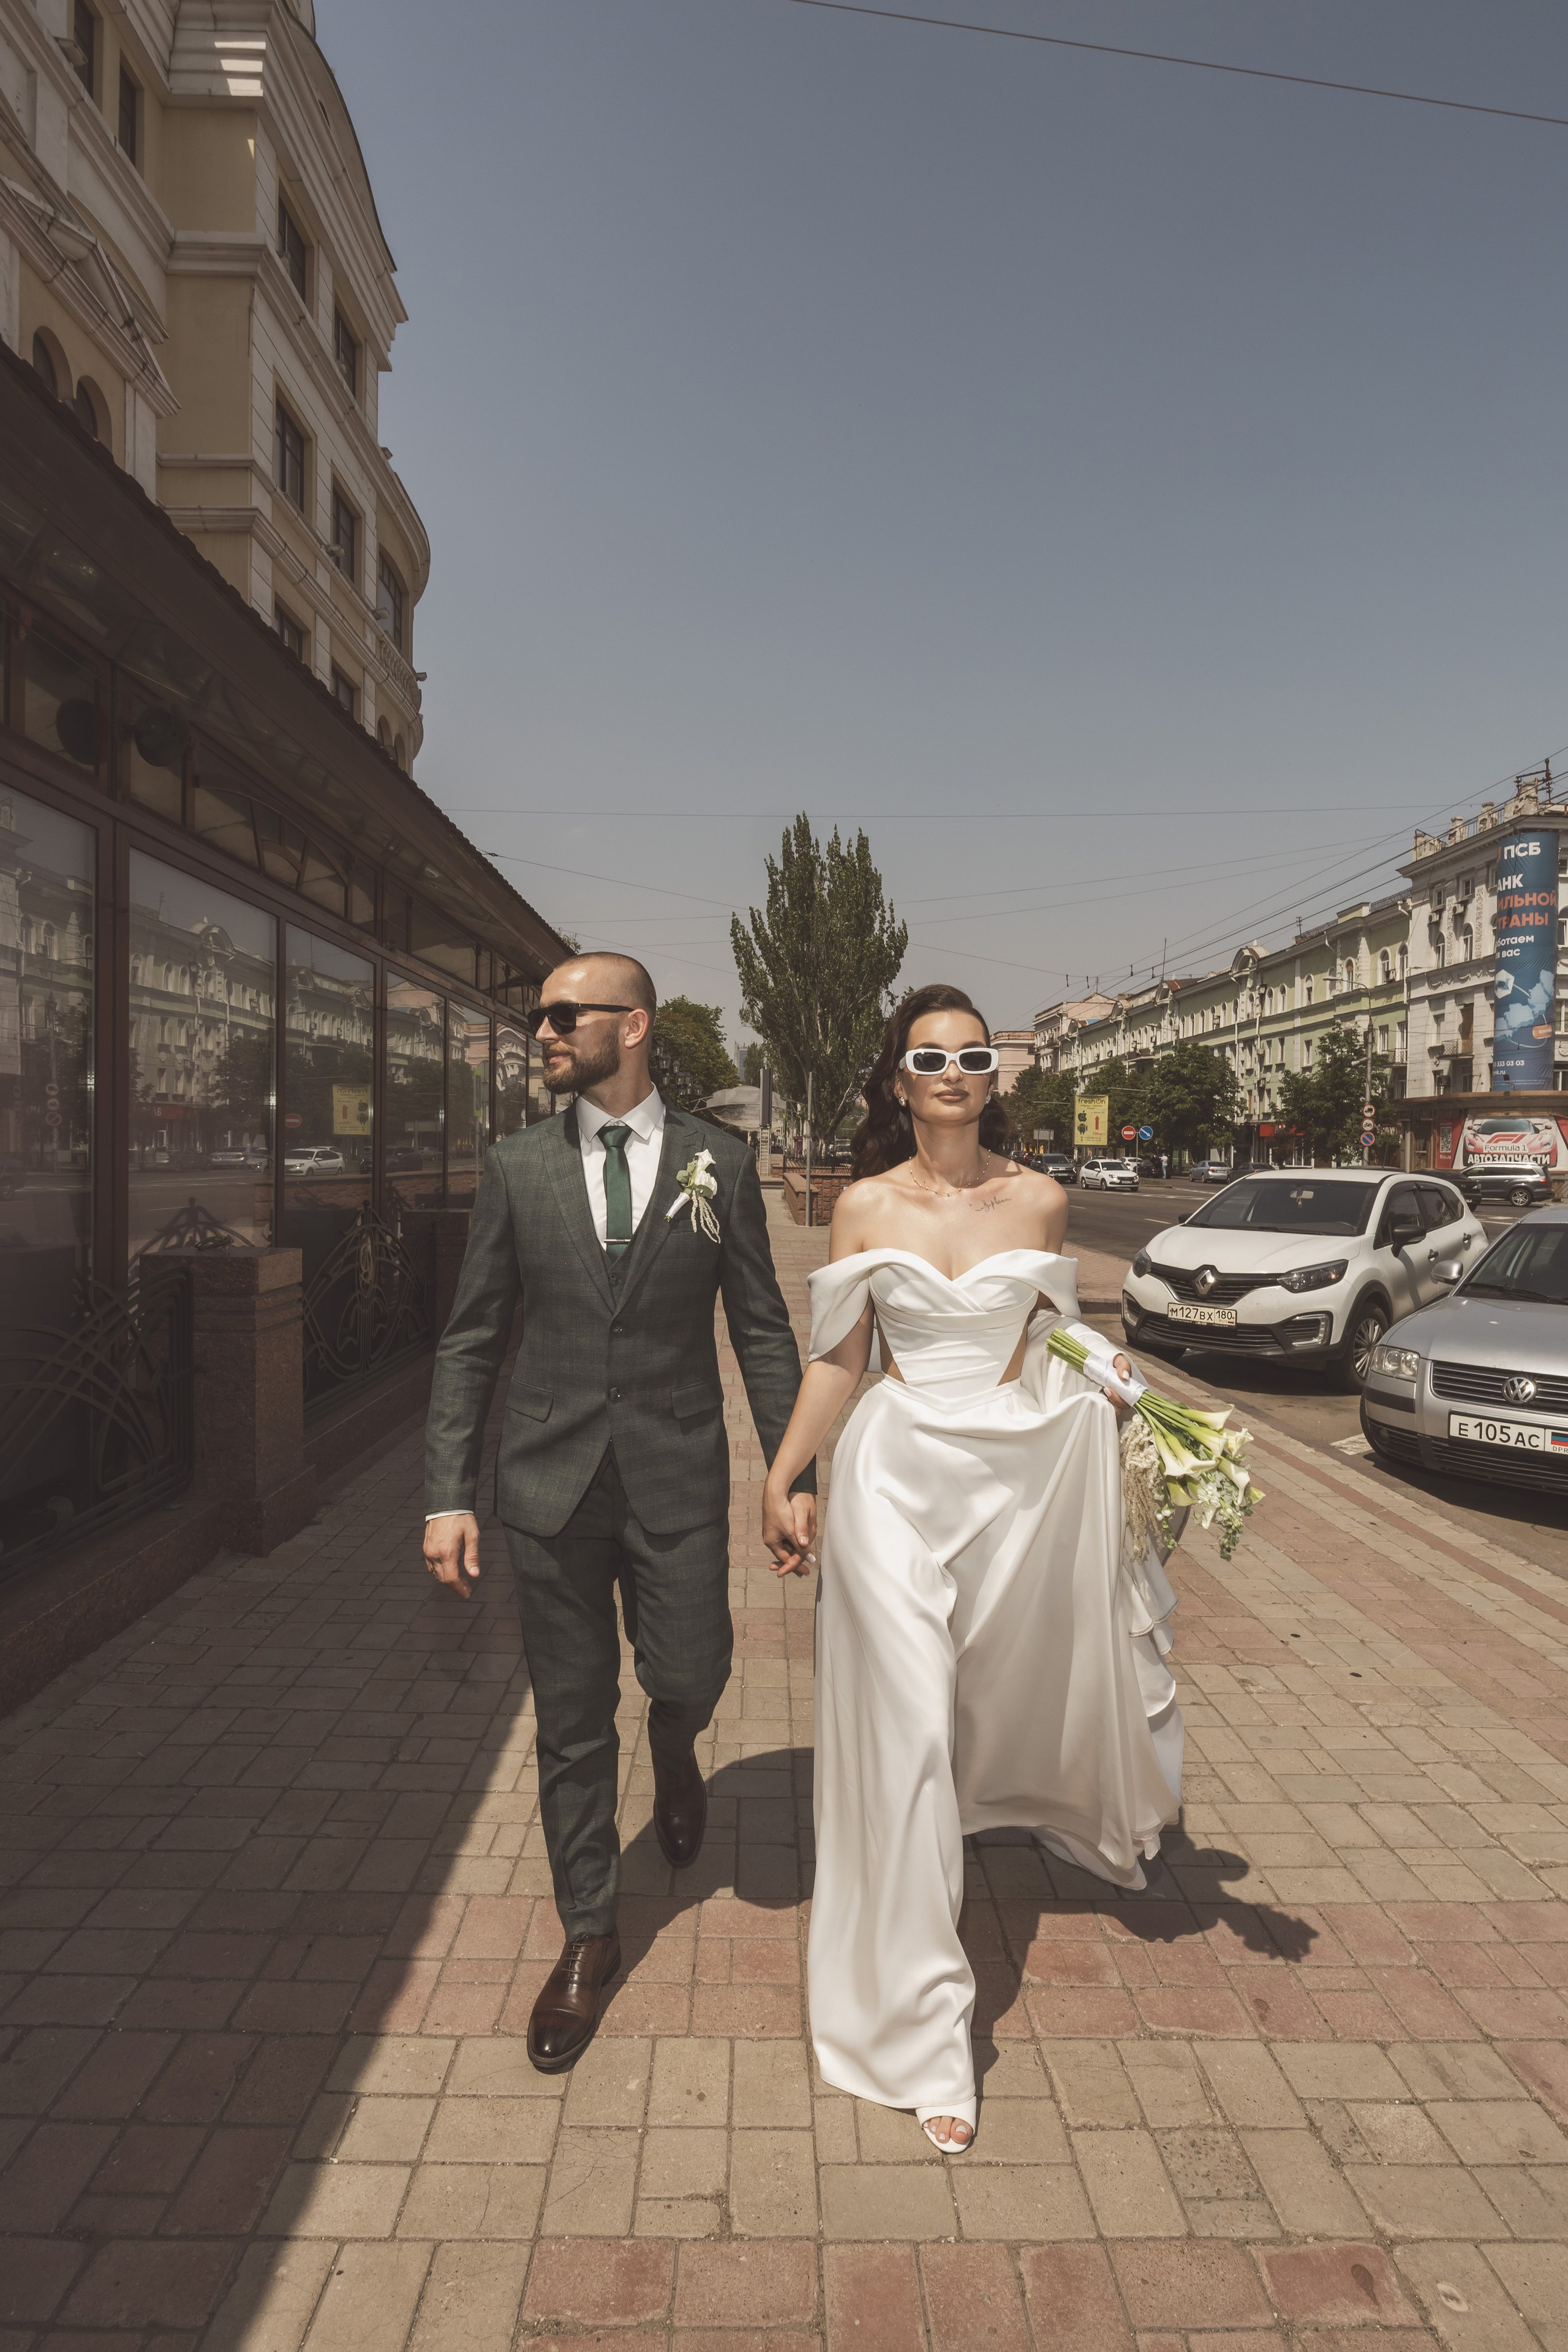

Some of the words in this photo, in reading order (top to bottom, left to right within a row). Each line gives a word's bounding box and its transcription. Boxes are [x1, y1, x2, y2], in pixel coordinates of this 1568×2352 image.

[1504, 842, 1541, 860] ПСБ
[1496, 935, 1534, 948] ботаем
[1502, 949, 1520, 957] вас
[1468, 1153, 1550, 1164] АВТОЗАПЧАСТИ
[1216, 1310, 1232, 1320] 180
